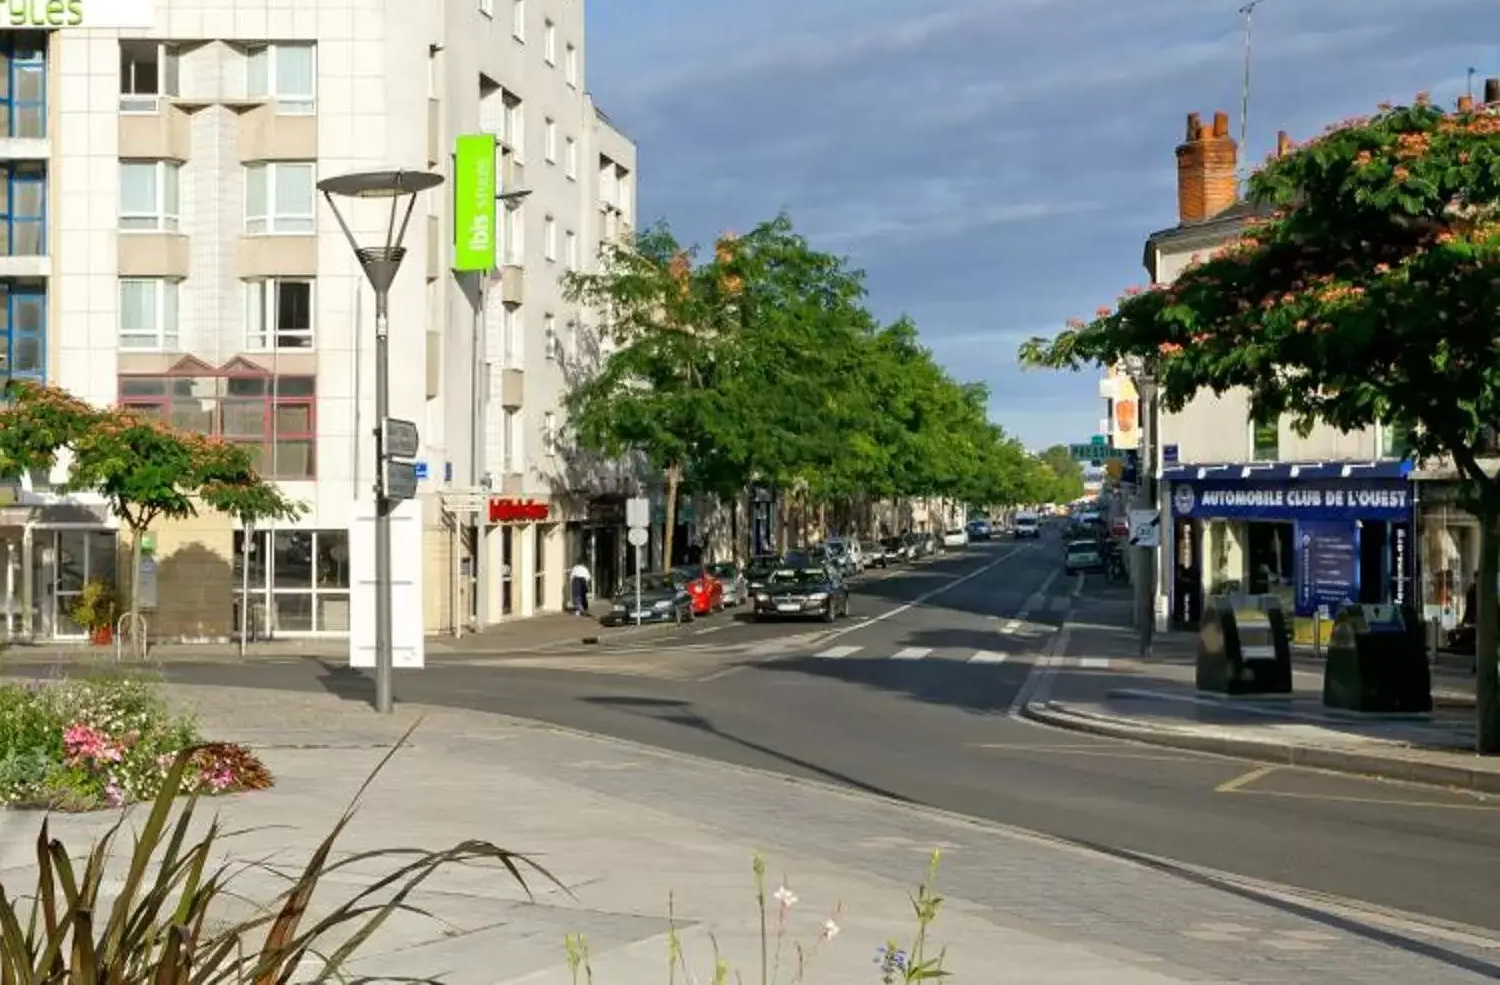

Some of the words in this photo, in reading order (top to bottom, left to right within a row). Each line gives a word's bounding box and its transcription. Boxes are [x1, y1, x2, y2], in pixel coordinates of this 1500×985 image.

[469, 214, 489, 251] ibis
[1201, 490, 1283, 506] AUTOMOBILE
[1286, 490, 1322, 506] CLUB
[1325, 490, 1344, 507] DE
[1347, 490, 1407, 507] L'OUEST
